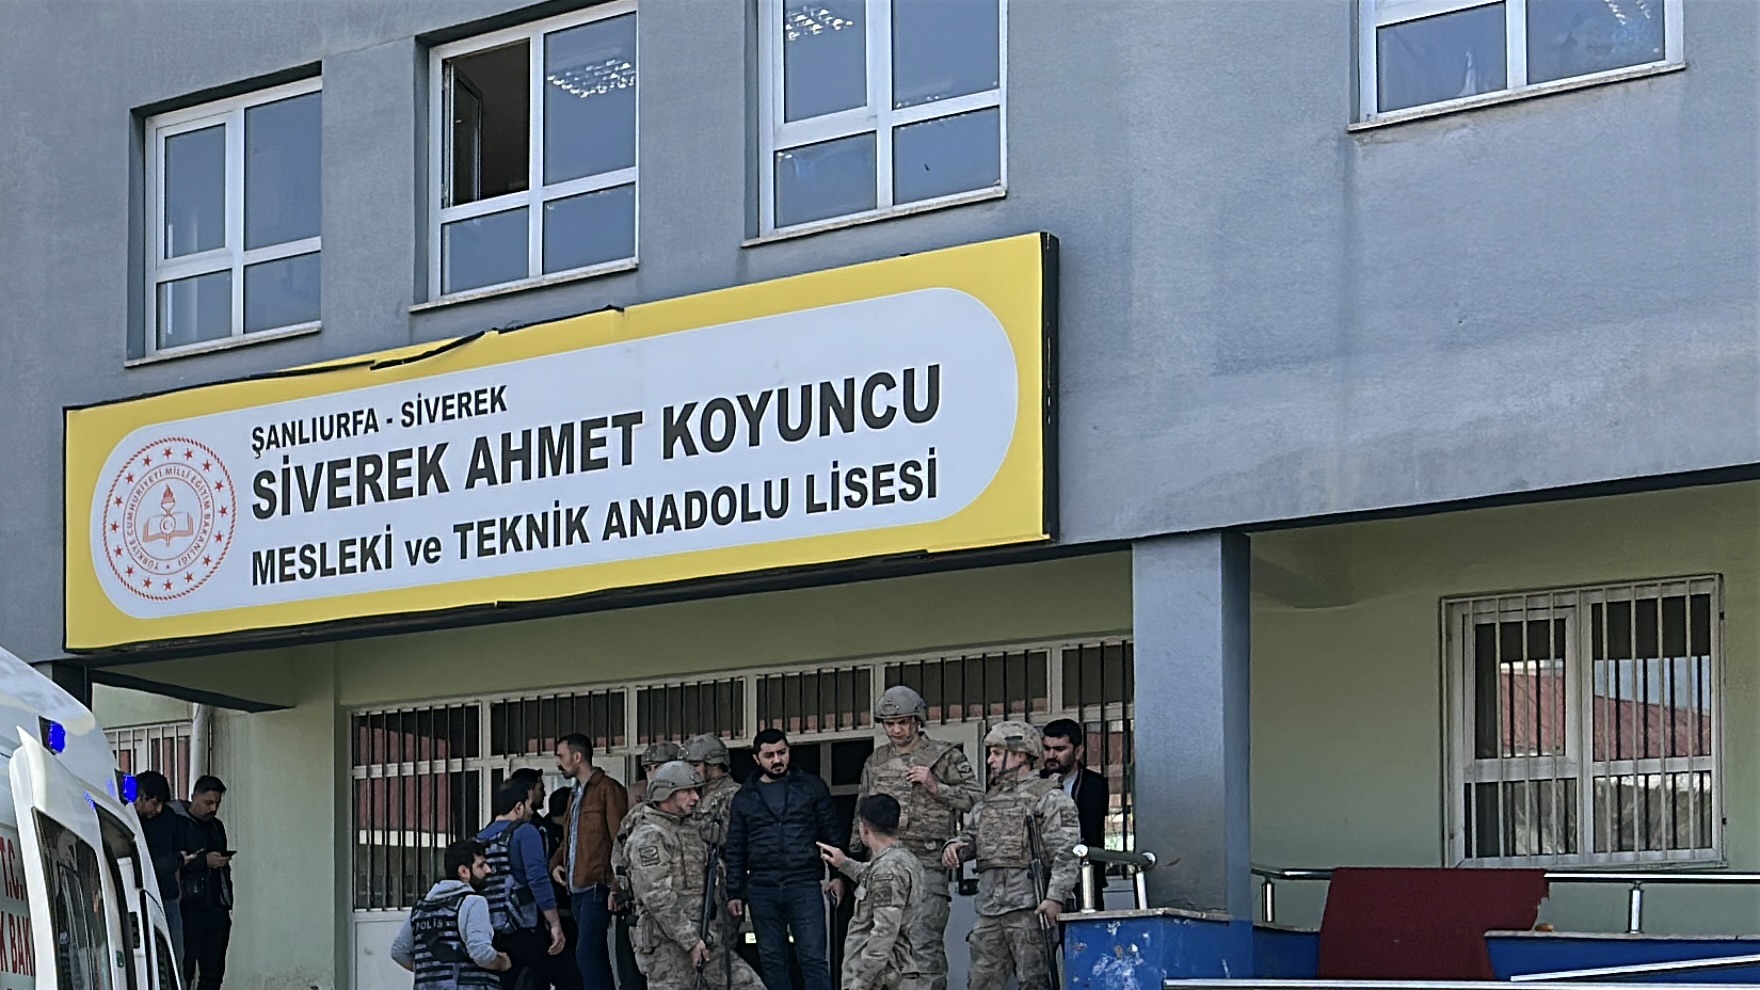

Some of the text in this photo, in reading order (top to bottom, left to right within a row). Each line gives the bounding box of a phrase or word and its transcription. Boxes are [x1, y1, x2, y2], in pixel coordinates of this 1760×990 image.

[251, 407, 380, 460] ŞANLIURFA
[400, 384, 508, 428] SİVEREK
[252, 363, 940, 520] SİVEREK AHMET KOYUNCU
[165, 466, 191, 479] MİLLİ
[252, 446, 937, 587] MESLEKİ ve TEKNİK ANADOLU LİSESİ
[8, 912, 36, 978] BAK
